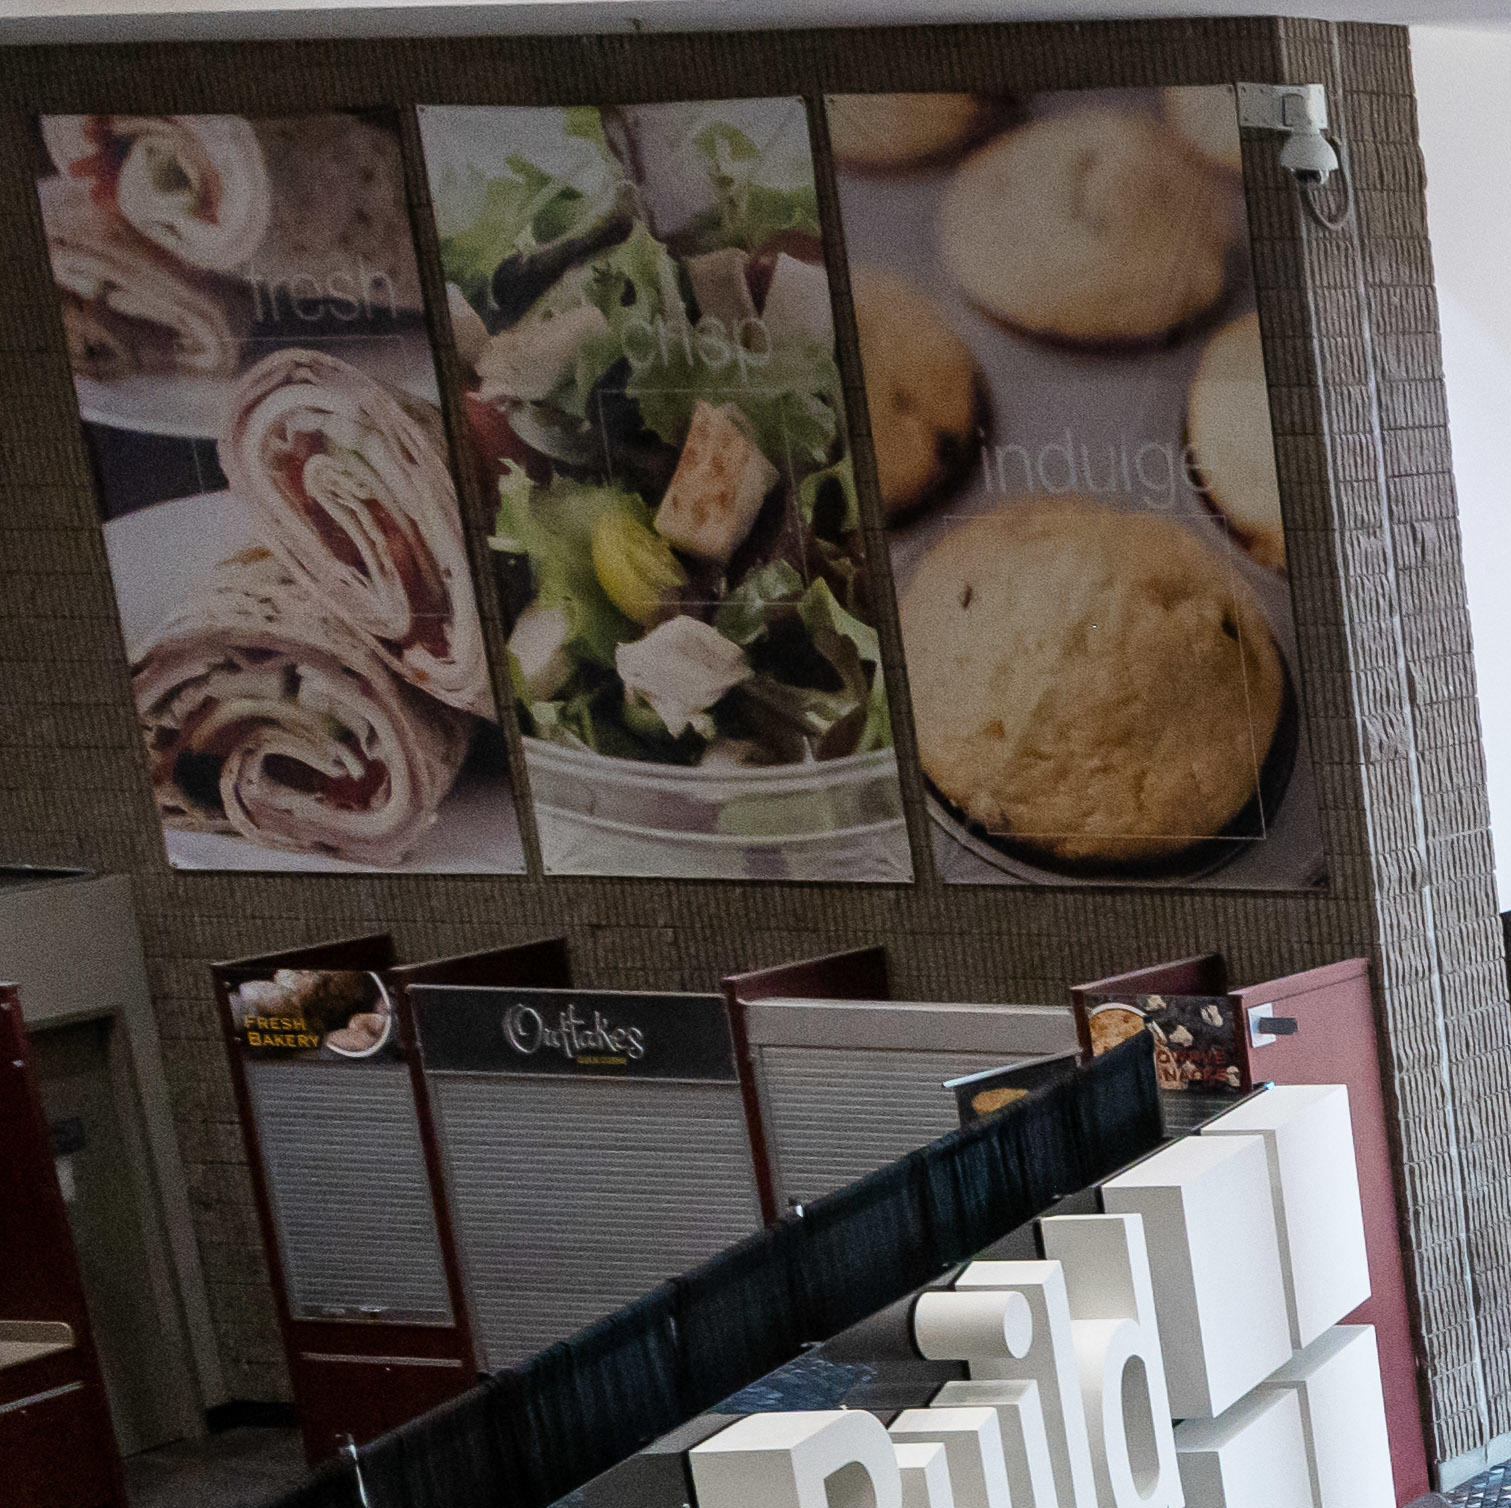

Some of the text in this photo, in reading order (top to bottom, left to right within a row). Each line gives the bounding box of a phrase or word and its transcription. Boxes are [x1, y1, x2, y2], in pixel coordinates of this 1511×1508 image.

[248, 262, 400, 325] fresh
[620, 306, 772, 384] crisp
[979, 424, 1212, 509] indulge
[244, 1015, 307, 1031] FRESH
[247, 1031, 320, 1049] BAKERY
